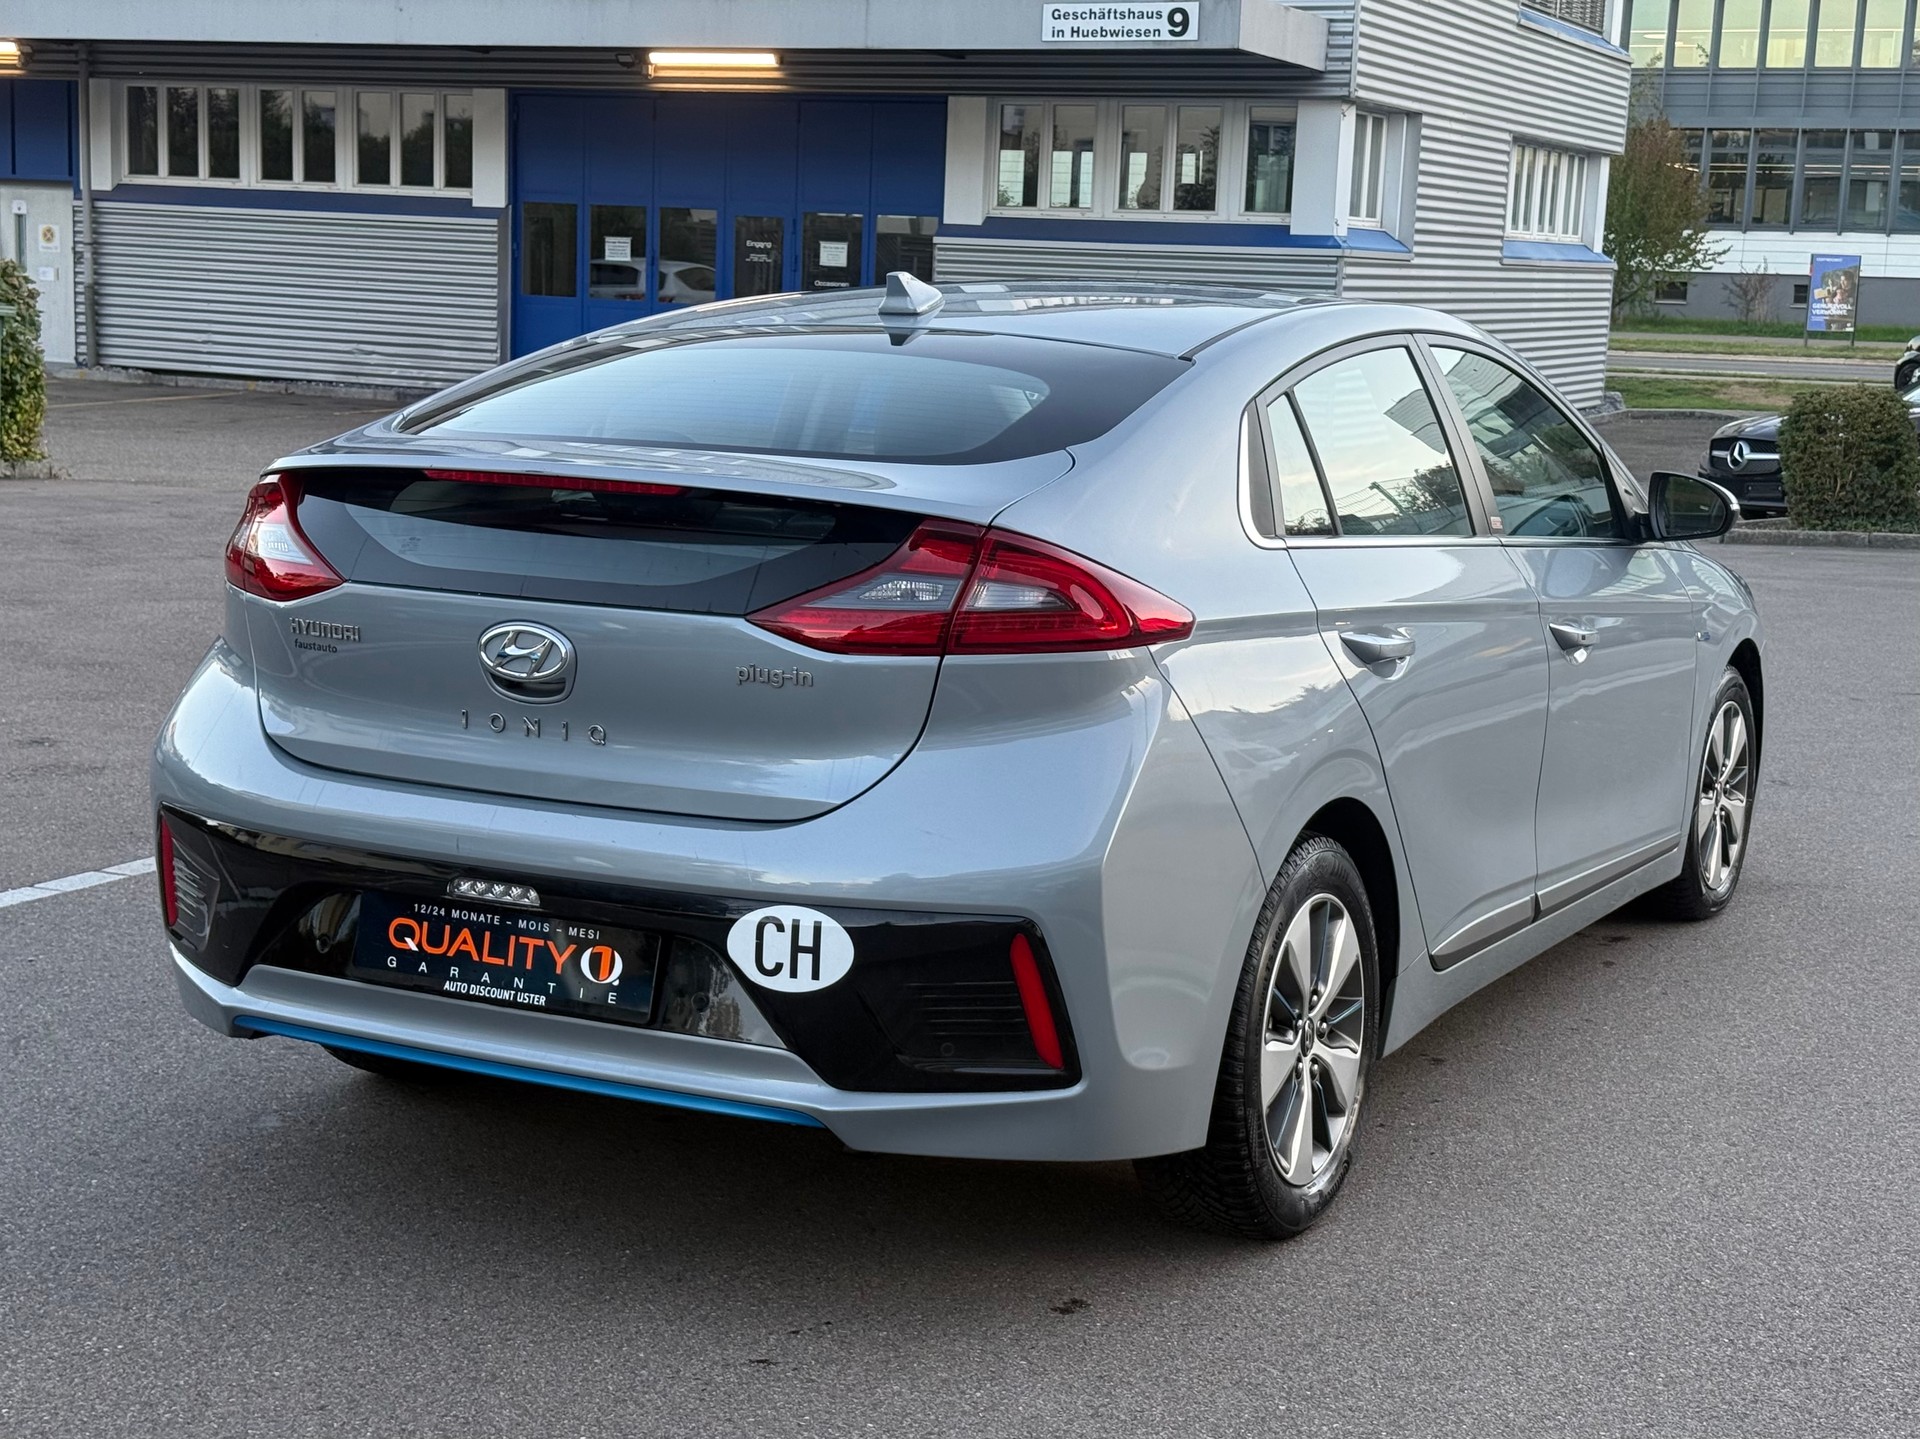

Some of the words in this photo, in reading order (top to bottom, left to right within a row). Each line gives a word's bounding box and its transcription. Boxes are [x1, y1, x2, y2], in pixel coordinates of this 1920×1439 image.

[1051, 8, 1163, 20] Geschäftshaus
[1167, 7, 1190, 37] 9
[1051, 26, 1065, 38] in
[1070, 26, 1161, 38] Huebwiesen
[289, 617, 361, 642] HYUNDAI
[294, 638, 338, 653] faustauto
[736, 663, 814, 688] plug-in
[461, 709, 607, 746] IONIQ
[413, 903, 445, 916] 12/24
[451, 908, 501, 925] MONATE
[518, 919, 550, 933] MOIS
[568, 927, 601, 940] MESI
[388, 917, 578, 975] QUALITY
[755, 915, 822, 981] CH
[387, 956, 618, 1004] GARANTIE
[443, 980, 468, 994] AUTO
[469, 984, 516, 1001] DISCOUNT
[517, 991, 546, 1006] USTER
